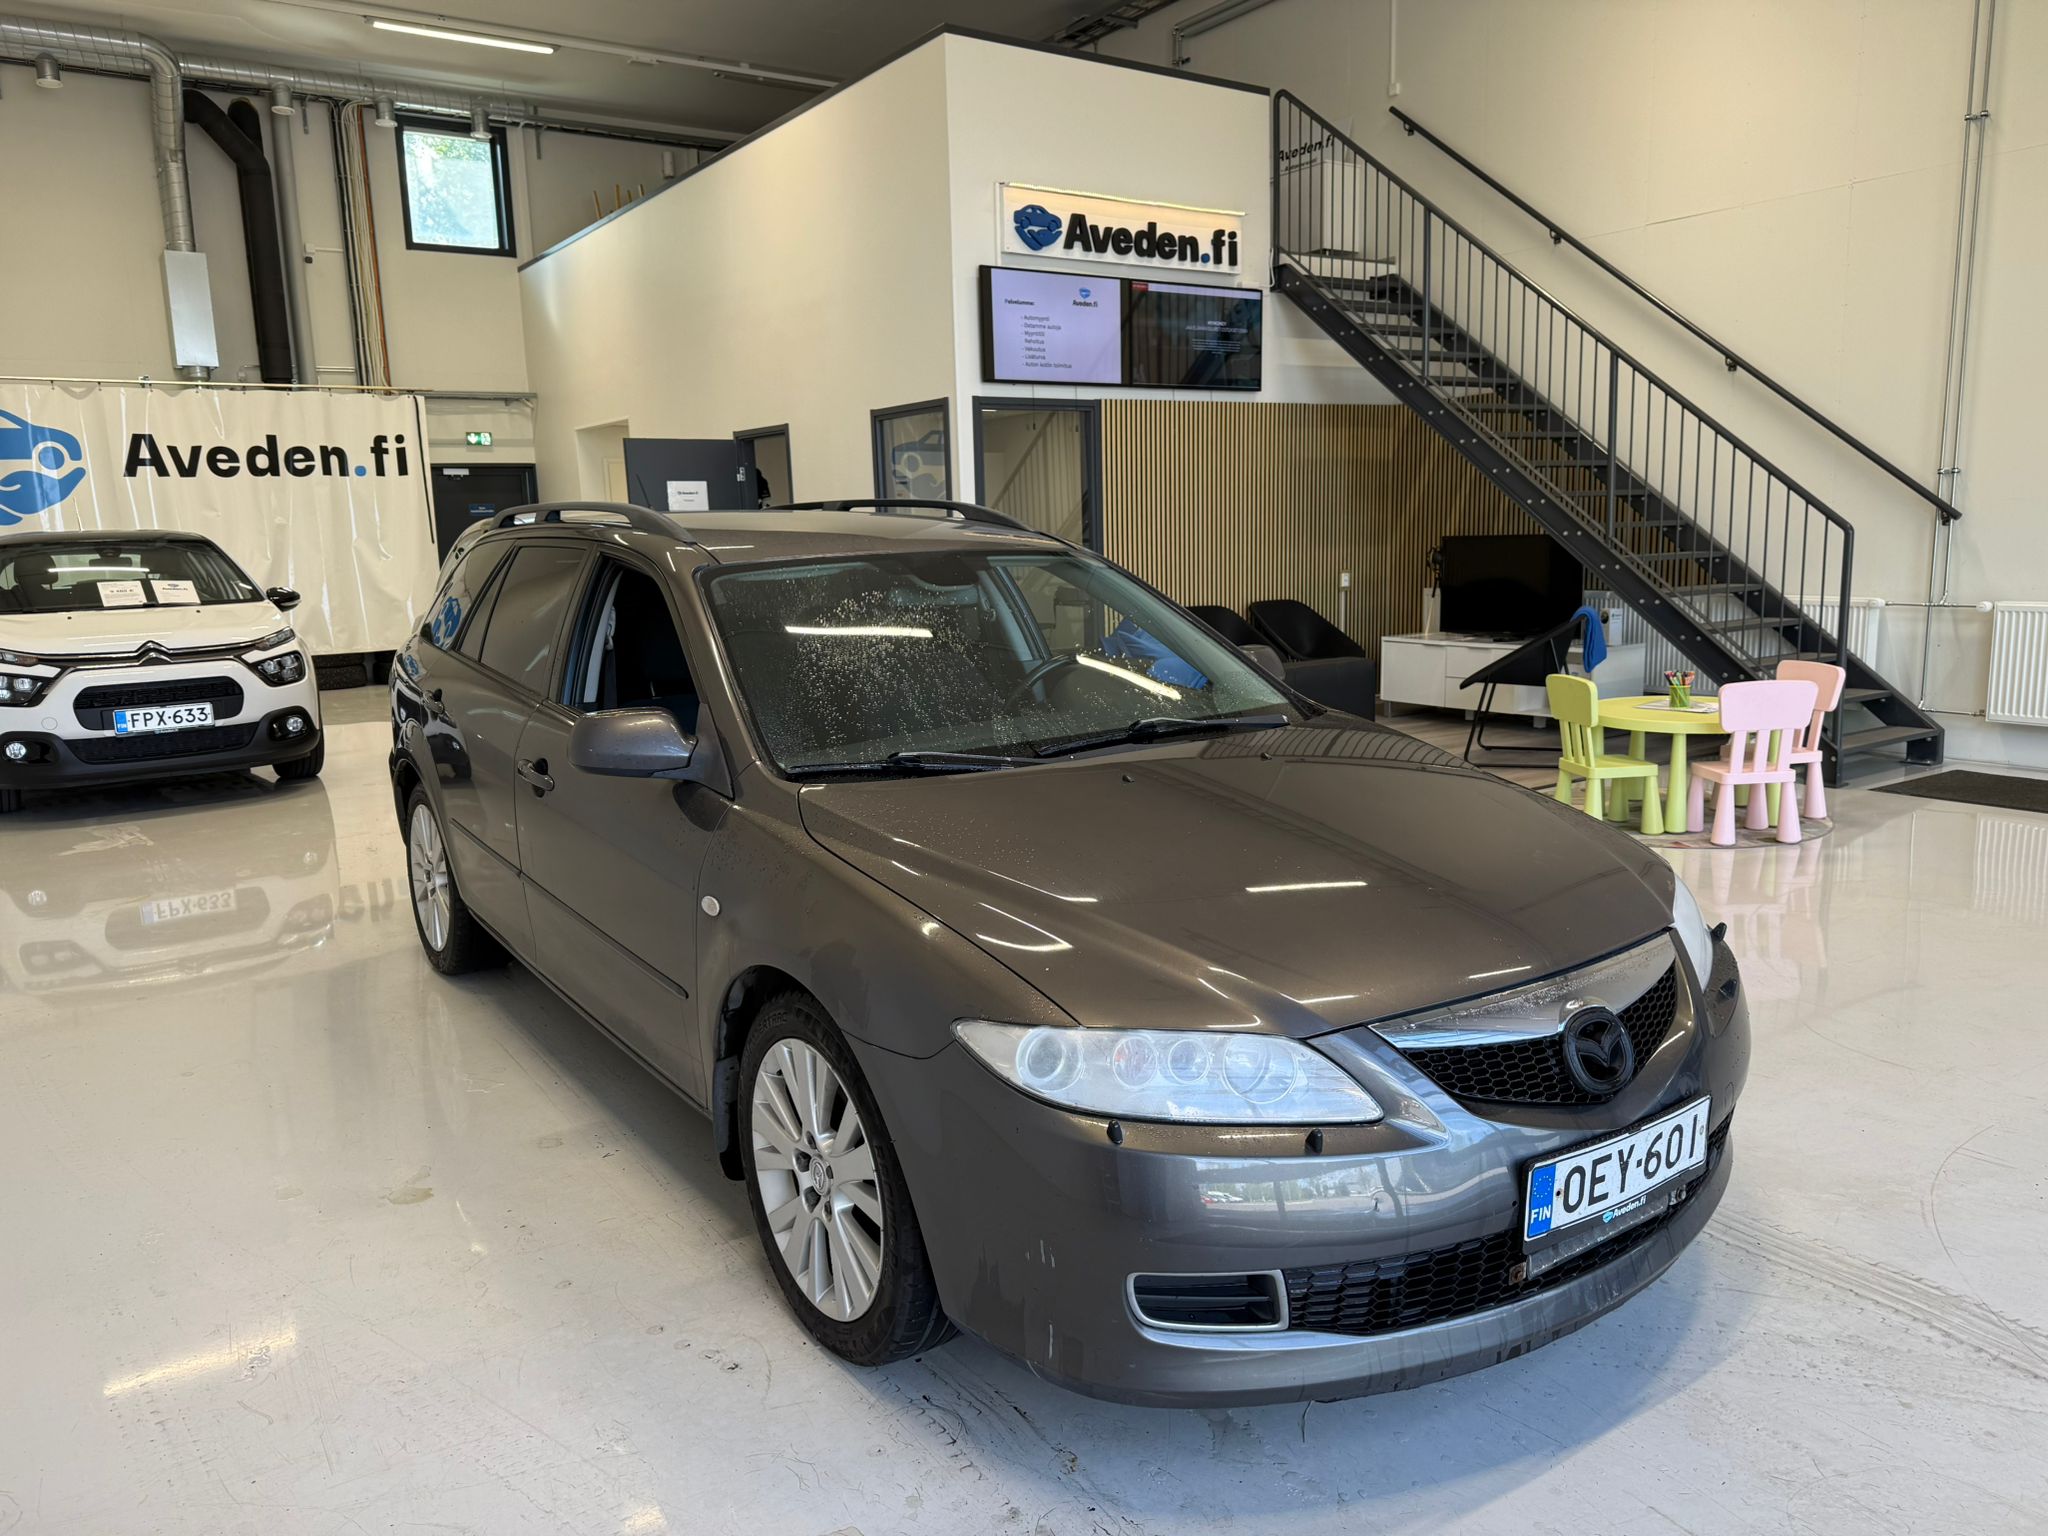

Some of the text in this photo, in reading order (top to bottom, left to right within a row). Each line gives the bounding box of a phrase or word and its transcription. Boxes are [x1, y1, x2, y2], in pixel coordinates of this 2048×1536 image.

[1063, 213, 1238, 267] Aveden.fi
[1072, 299, 1099, 308] Aveden.fi
[124, 433, 409, 478] Aveden.fi
[130, 707, 208, 728] FPX-633
[1530, 1113, 1699, 1225] FIN OEY-601
[1612, 1194, 1647, 1219] Aveden.fi
